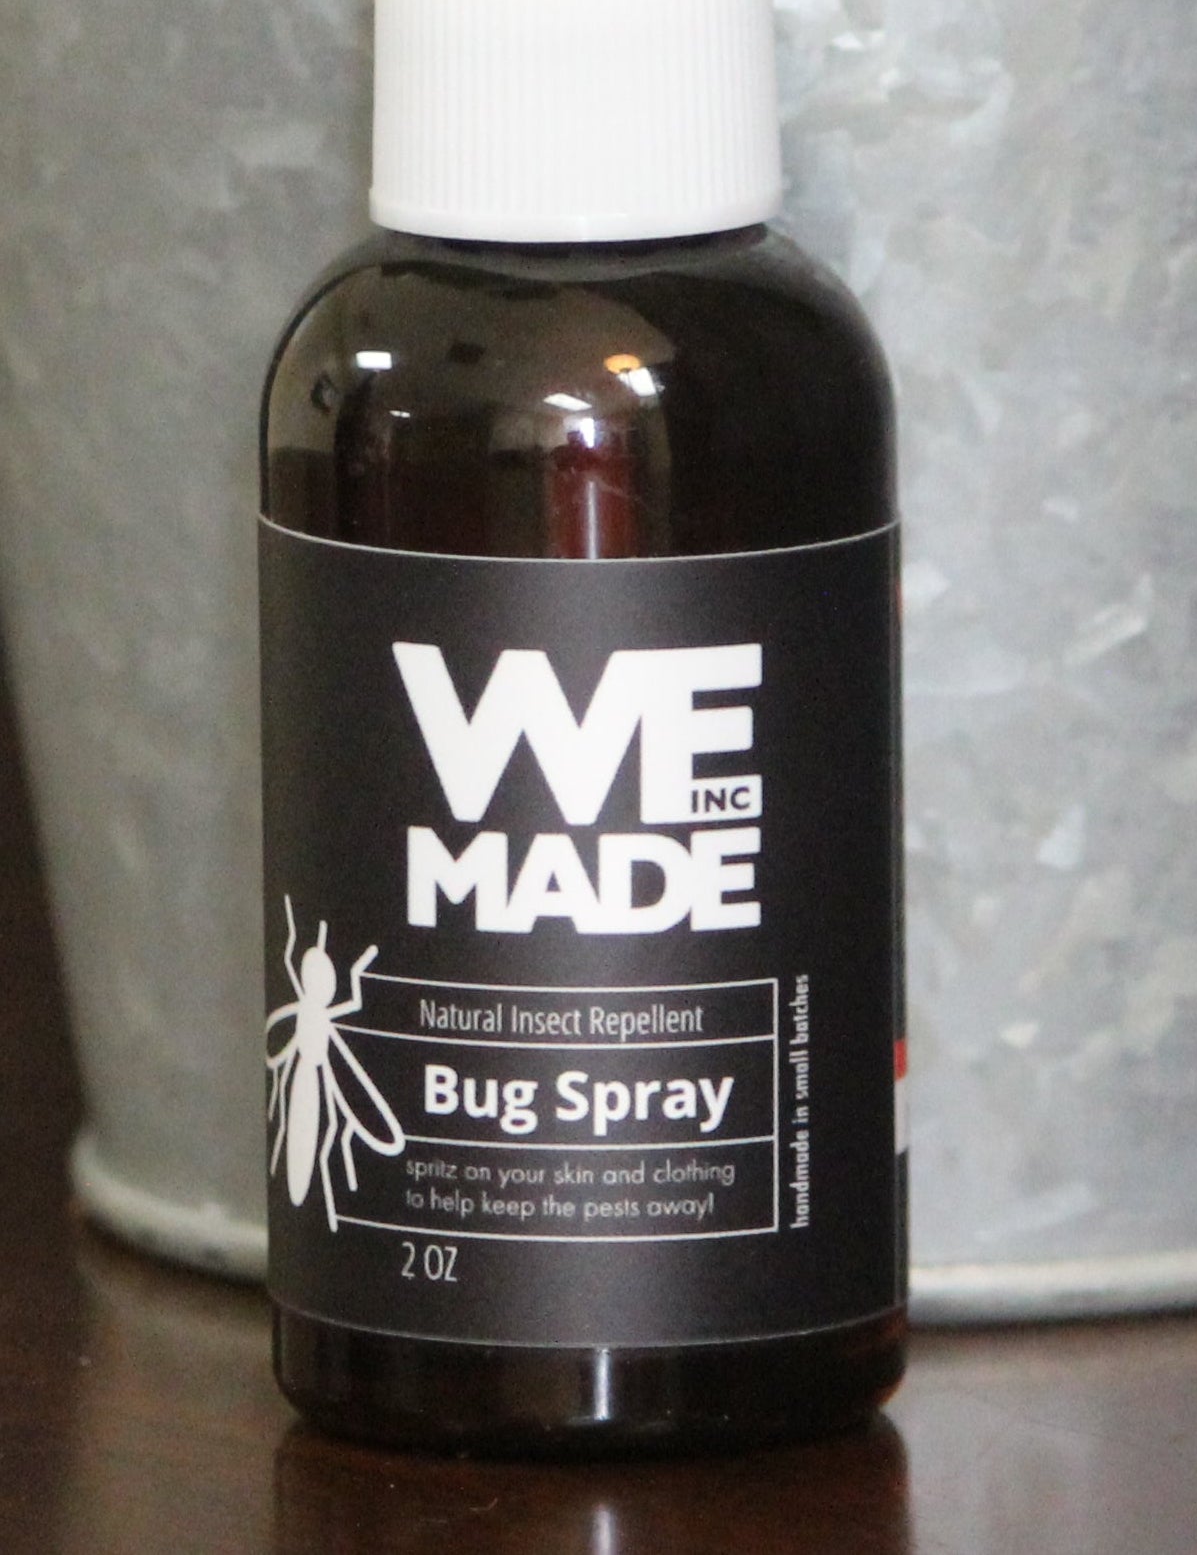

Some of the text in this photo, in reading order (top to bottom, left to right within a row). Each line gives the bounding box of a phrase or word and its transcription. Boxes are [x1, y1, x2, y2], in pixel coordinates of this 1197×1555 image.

[392, 641, 762, 825] WE
[691, 786, 751, 813] INC
[407, 825, 762, 935] MADE
[419, 999, 704, 1042] Natural Insect Repellent
[424, 1064, 735, 1136] Bug Spray
[788, 974, 810, 1229] handmade in small batches
[406, 1158, 736, 1189] spritz on your skin and clothing
[406, 1187, 715, 1223] to help keep the pests away!
[401, 1241, 459, 1282] 2 OZ
